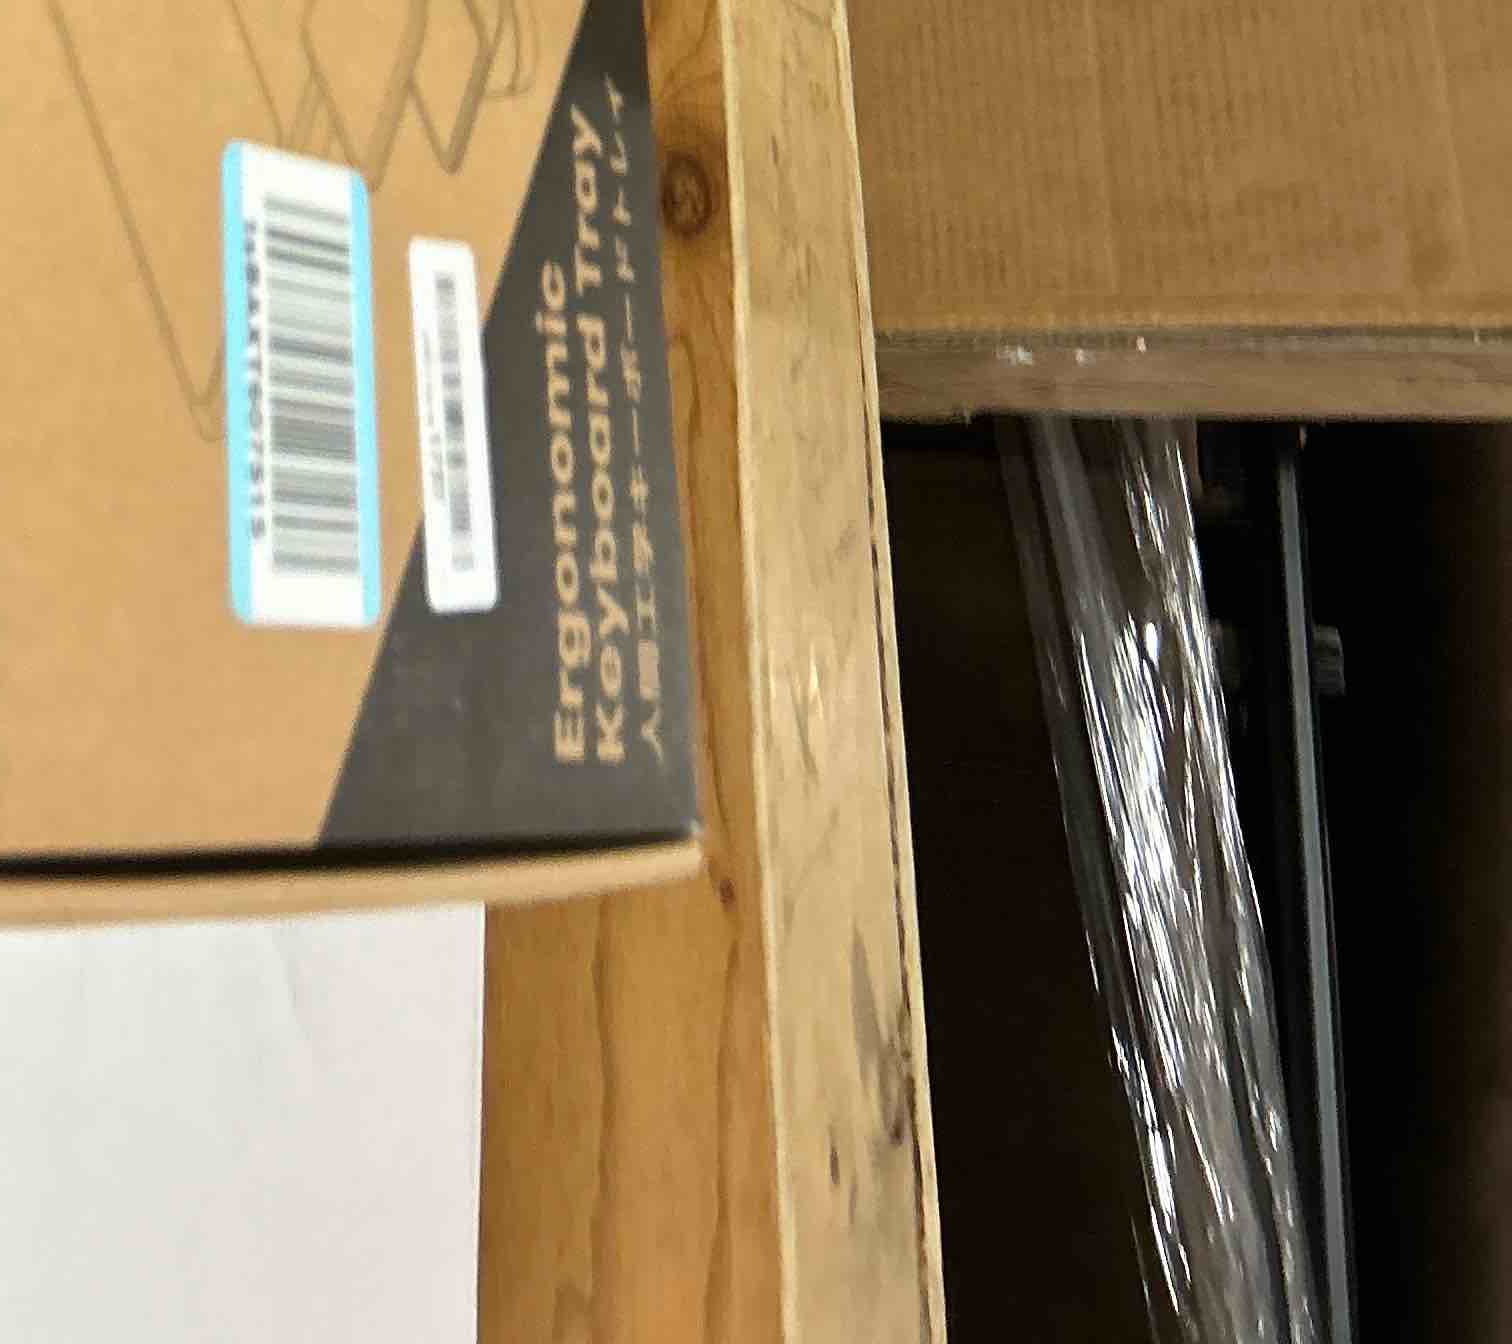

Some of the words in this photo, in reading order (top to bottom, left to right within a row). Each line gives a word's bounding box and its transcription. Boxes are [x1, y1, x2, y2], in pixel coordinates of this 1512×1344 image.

[570, 103, 604, 296] Tray
[535, 260, 592, 765] Ergonomic
[576, 314, 630, 765] Keyboard
